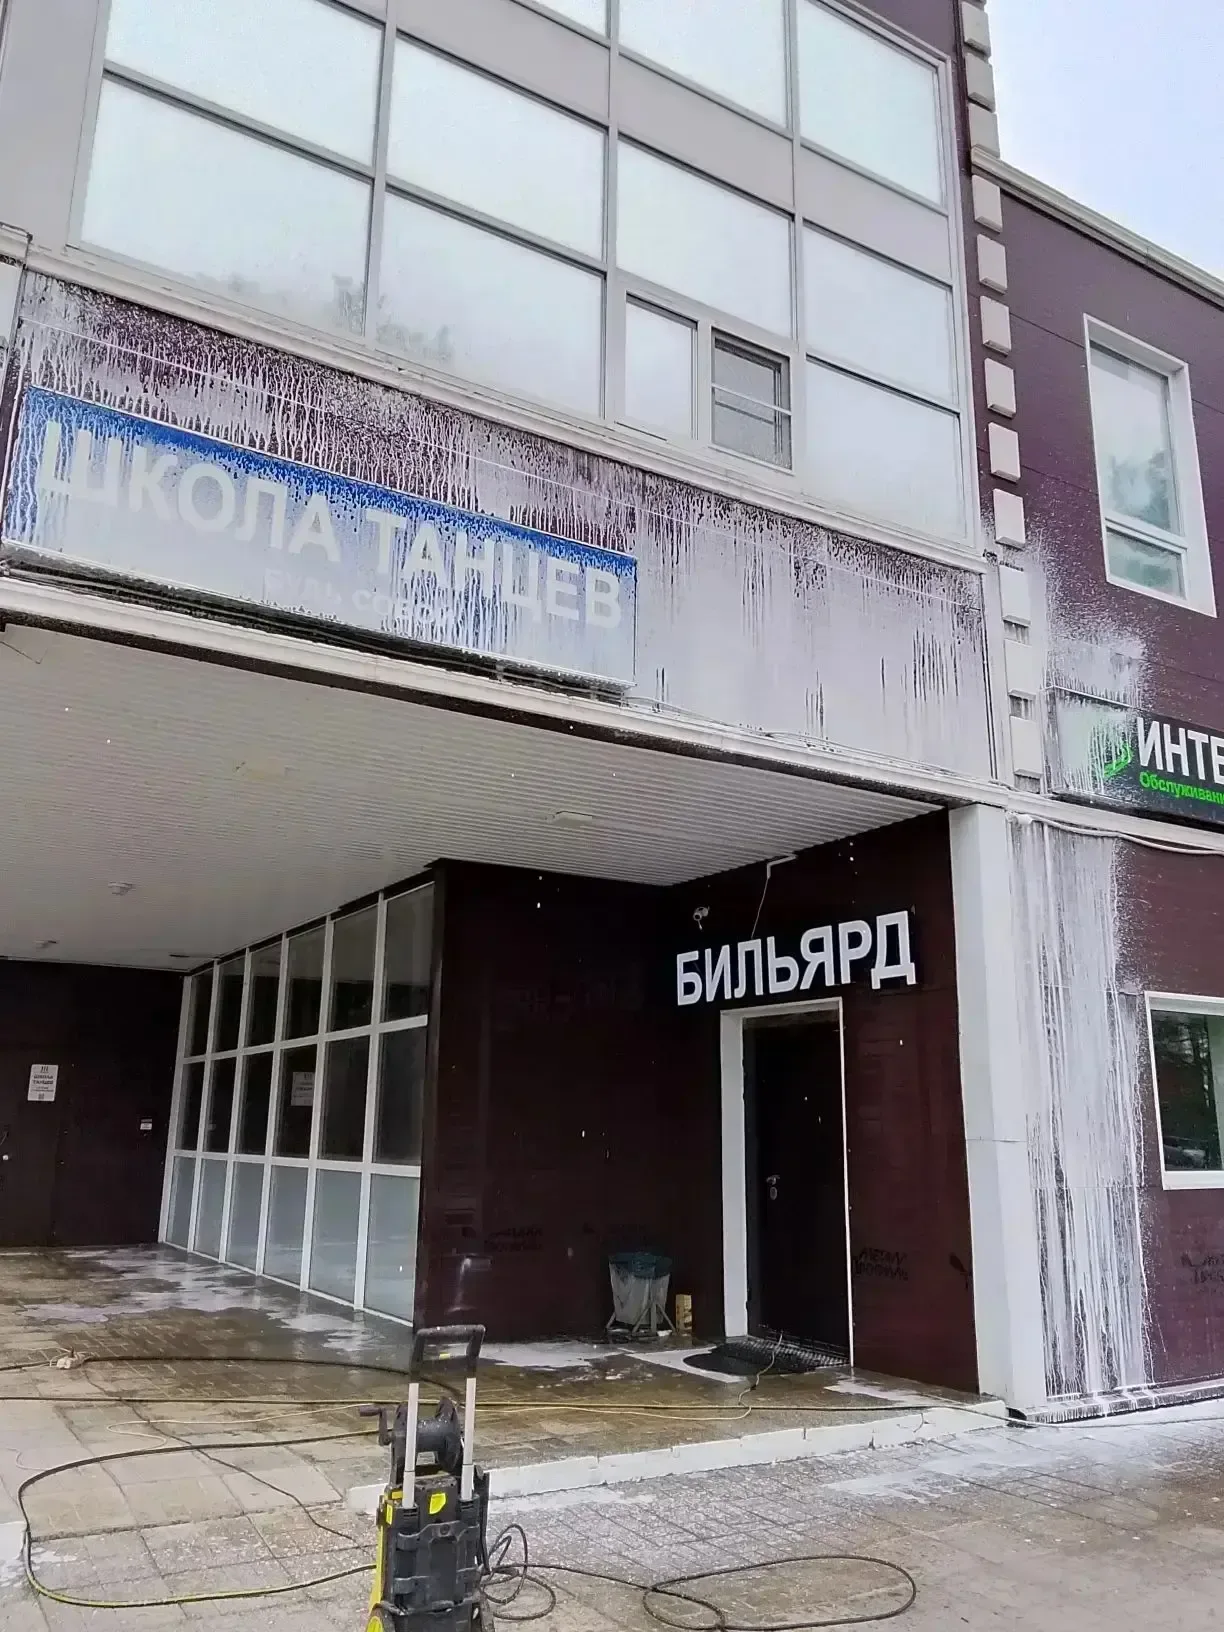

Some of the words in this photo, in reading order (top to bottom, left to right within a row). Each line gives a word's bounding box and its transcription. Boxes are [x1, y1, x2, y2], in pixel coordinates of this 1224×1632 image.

[37, 420, 341, 562] ШКОЛА
[366, 508, 622, 628] ТАНЦЕВ
[1137, 716, 1224, 785] ИНТЕ
[677, 911, 916, 1005] БИЛЬЯРД
